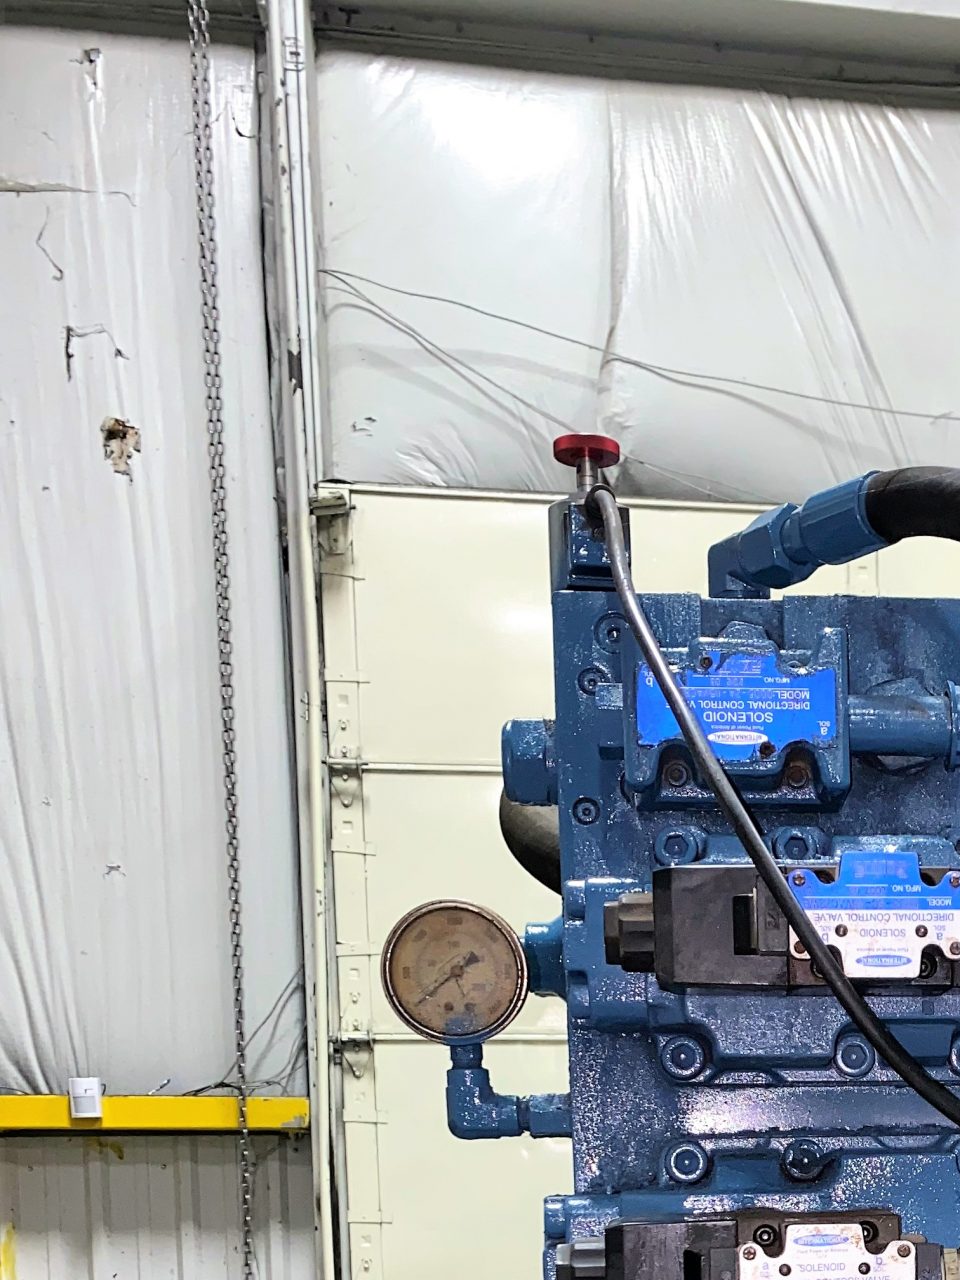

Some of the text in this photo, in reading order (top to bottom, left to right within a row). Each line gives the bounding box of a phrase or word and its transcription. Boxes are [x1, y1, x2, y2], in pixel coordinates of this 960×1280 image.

[698, 700, 744, 709] CONTROL
[746, 701, 810, 710] DIRECTIONAL
[704, 711, 773, 722] SOLENOID
[813, 913, 954, 922] DIRECTIONAL CONTROL VALVE
[860, 928, 906, 937] SOLENOID
[936, 933, 943, 941] a
[800, 1263, 845, 1272] SOLENOID
